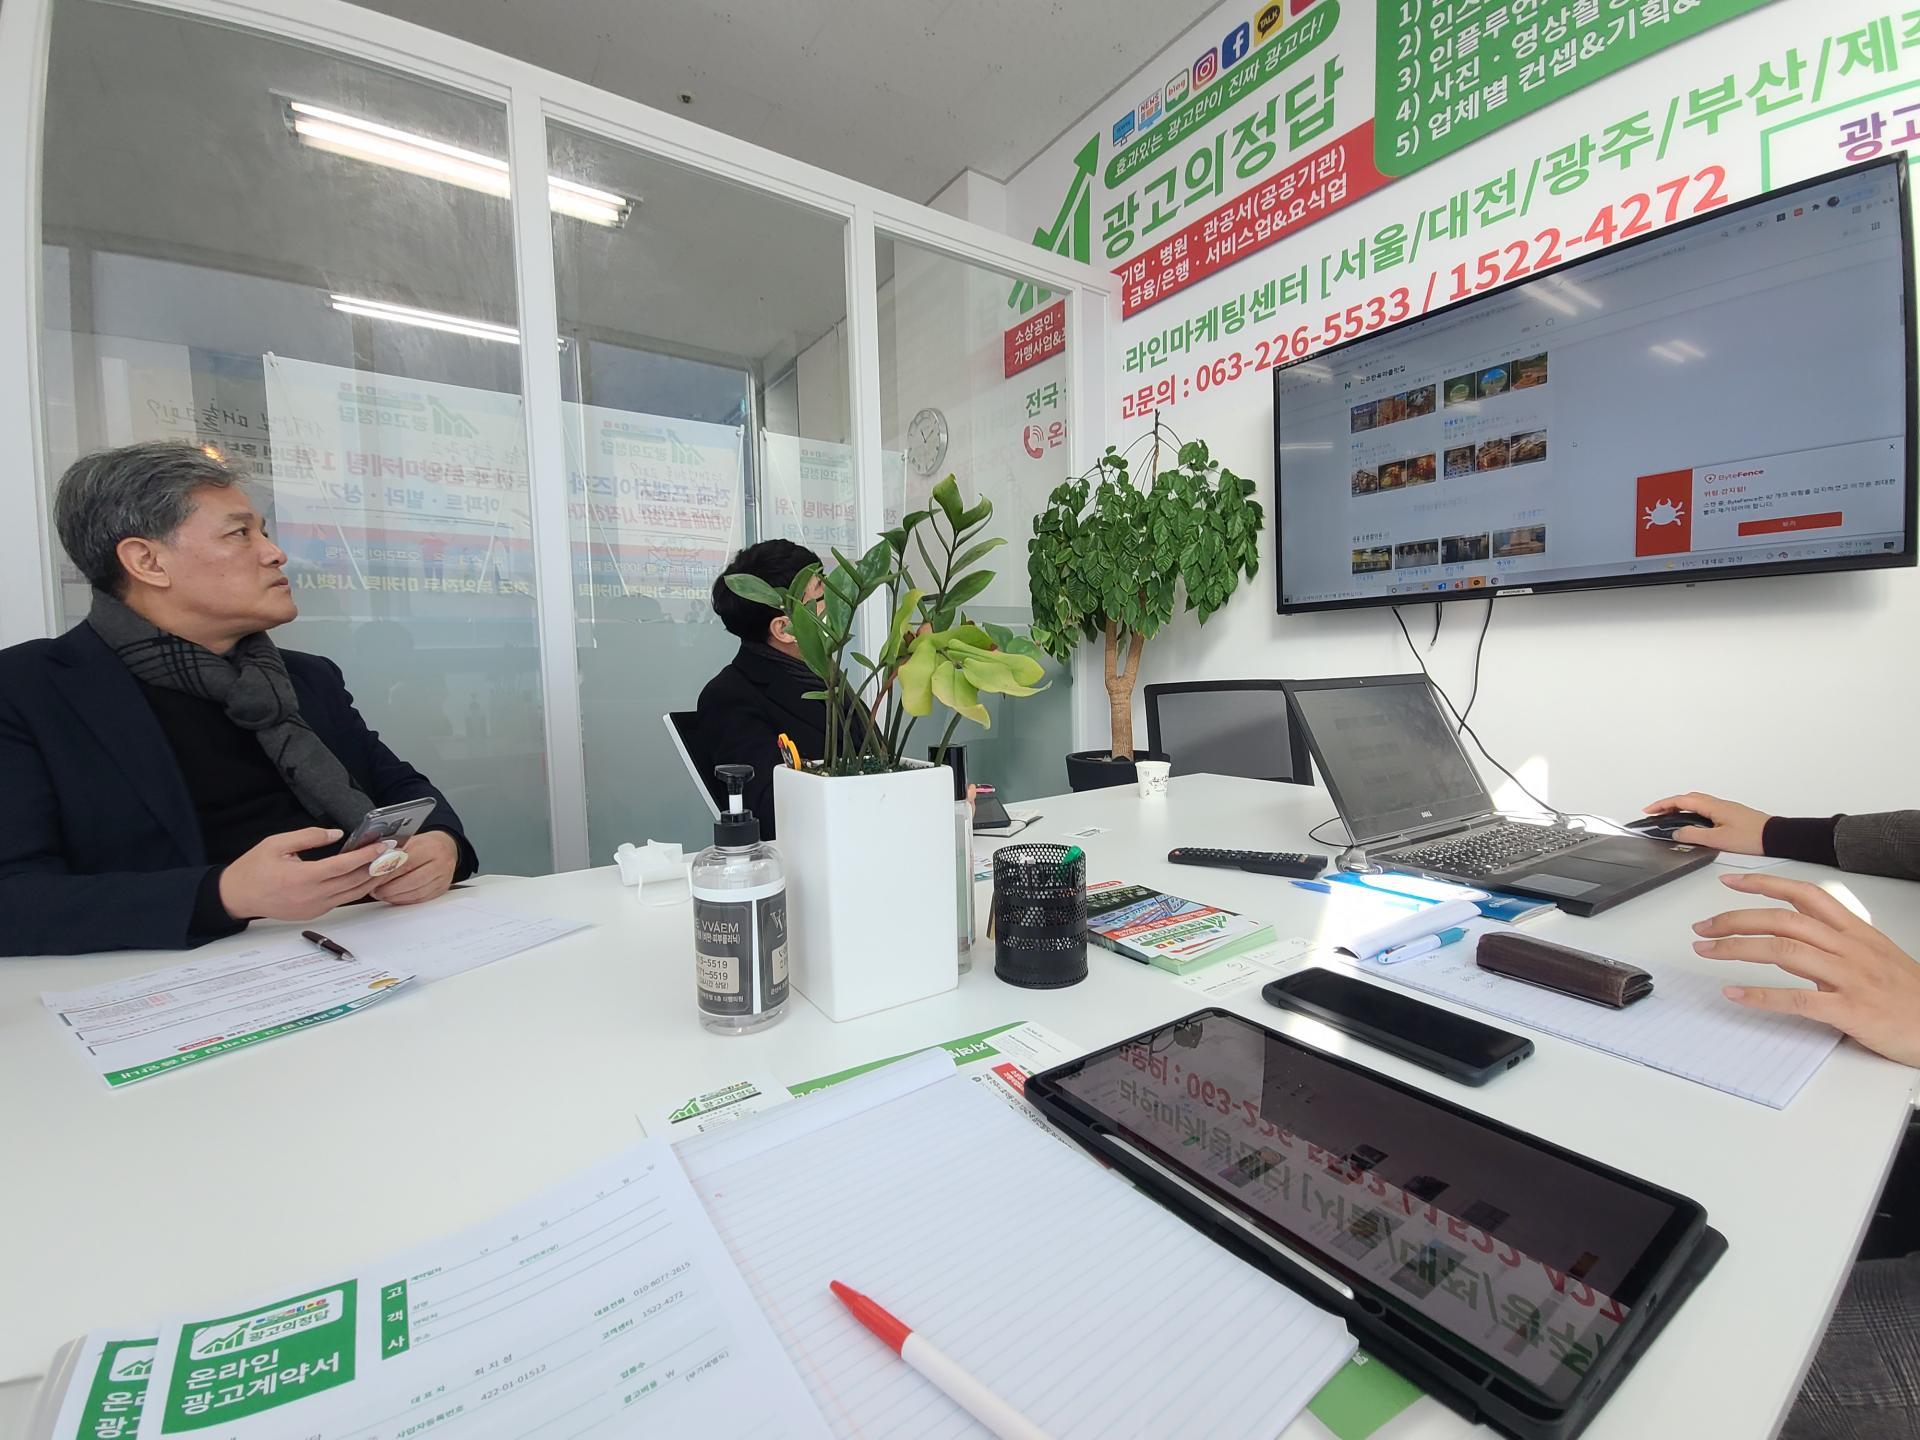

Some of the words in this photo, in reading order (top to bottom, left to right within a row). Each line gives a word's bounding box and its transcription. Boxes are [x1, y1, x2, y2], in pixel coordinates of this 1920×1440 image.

[1396, 60, 1421, 92] 3)
[1430, 0, 1552, 73] 인플루언
[1396, 92, 1420, 121] 4)
[1428, 54, 1480, 105] 사진
[1511, 0, 1626, 60] 영상촬
[1397, 26, 1421, 61] 2)
[1430, 0, 1493, 40] 인스
[1115, 133, 1163, 178] 효과있는
[1167, 86, 1223, 140] 광고만이
[1228, 60, 1260, 98] 진짜
[1264, 13, 1324, 72] 광고다!
[1140, 93, 1160, 113] NEWS
[1168, 79, 1186, 97] blog
[1396, 124, 1420, 157] 5)
[1428, 75, 1508, 141] 업체별
[1102, 55, 1344, 259] 광고의정답
[1014, 312, 1053, 345] 소상공인
[1160, 233, 1187, 270] 병원
[1203, 142, 1345, 239] 관공서(공공기관)
[1130, 262, 1190, 311] 금융/은행
[1205, 172, 1347, 264] 서비스업&요식업
[1196, 286, 1411, 392] 063-226-5533
[1449, 165, 1729, 303] 1522-4272
[1026, 382, 1058, 418] 전국
[1123, 271, 1308, 374] 라인마케팅센터
[1718, 469, 1764, 482] ByteFence
[187, 1349, 280, 1390] 온라인
[249, 1309, 330, 1343] 광고의정답
[181, 1352, 340, 1415] 광고계약서
